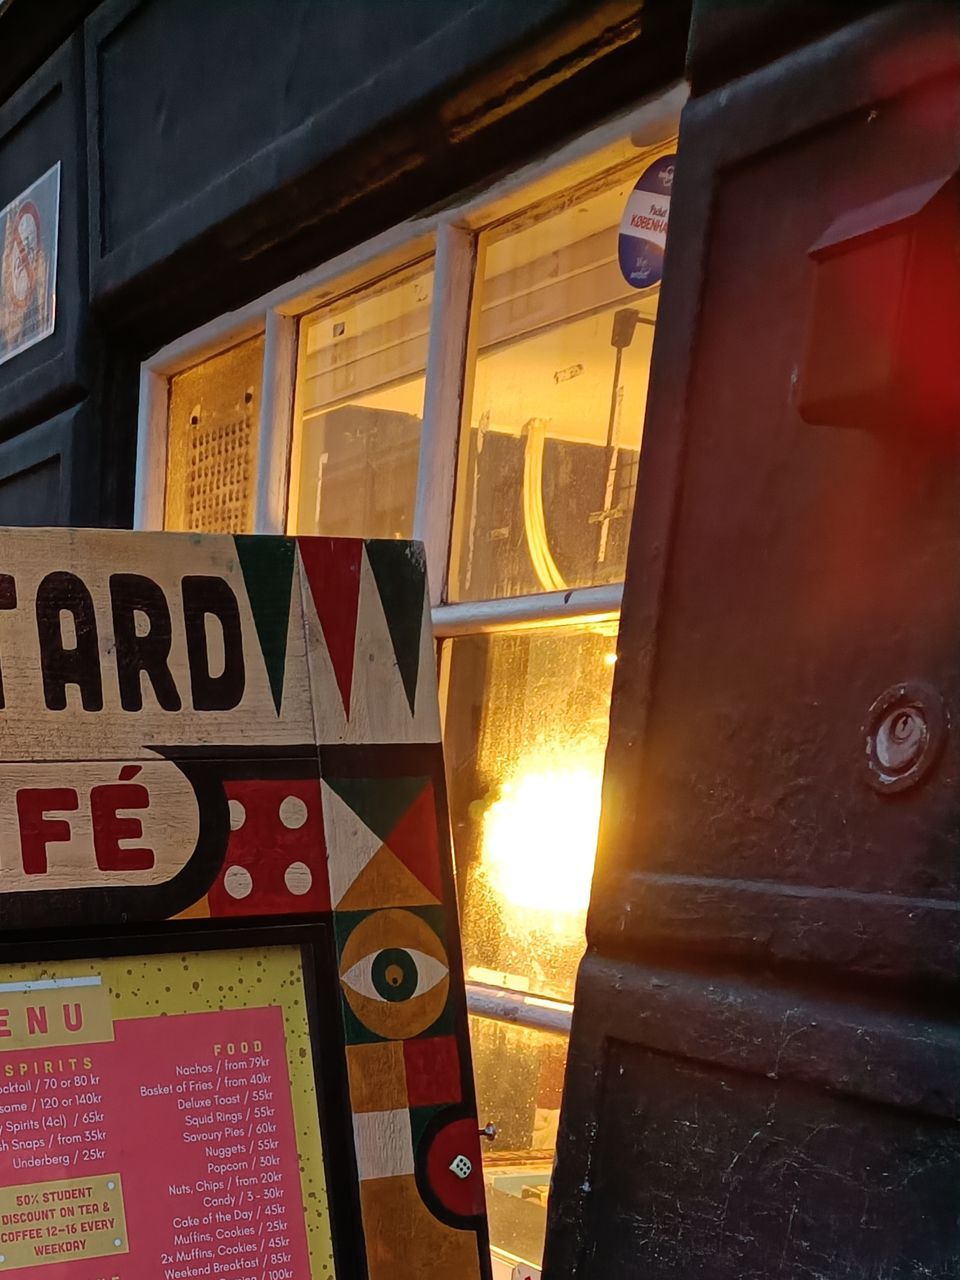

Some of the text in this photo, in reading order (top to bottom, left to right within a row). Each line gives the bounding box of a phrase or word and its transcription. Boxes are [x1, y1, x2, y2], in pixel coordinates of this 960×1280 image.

[213, 1040, 262, 1056] FOOD
[4, 1057, 92, 1077] SPIRITS
[175, 1055, 270, 1076] Nachos from 79kr
[177, 1088, 273, 1109] Deluxe Toast 55kr
[11, 1138, 45, 1151] Snaps
[56, 1132, 82, 1145] from
[84, 1128, 106, 1142] 35kr
[182, 1121, 276, 1143] Savoury Pies 60kr
[12, 1147, 105, 1169] Underberg 25kr
[205, 1138, 279, 1159] Nuggets 55kr
[207, 1154, 280, 1175] Popcorn 30kr
[15, 1186, 93, 1206] 50% STUDENT
[1, 1201, 110, 1225] DISCOUNT ON TEA &
[0, 1217, 115, 1243] COFFEE 12-16 EVERY
[33, 1238, 86, 1256] WEEKDAY
[164, 1252, 291, 1280] Weekend Breakfast 85kr
